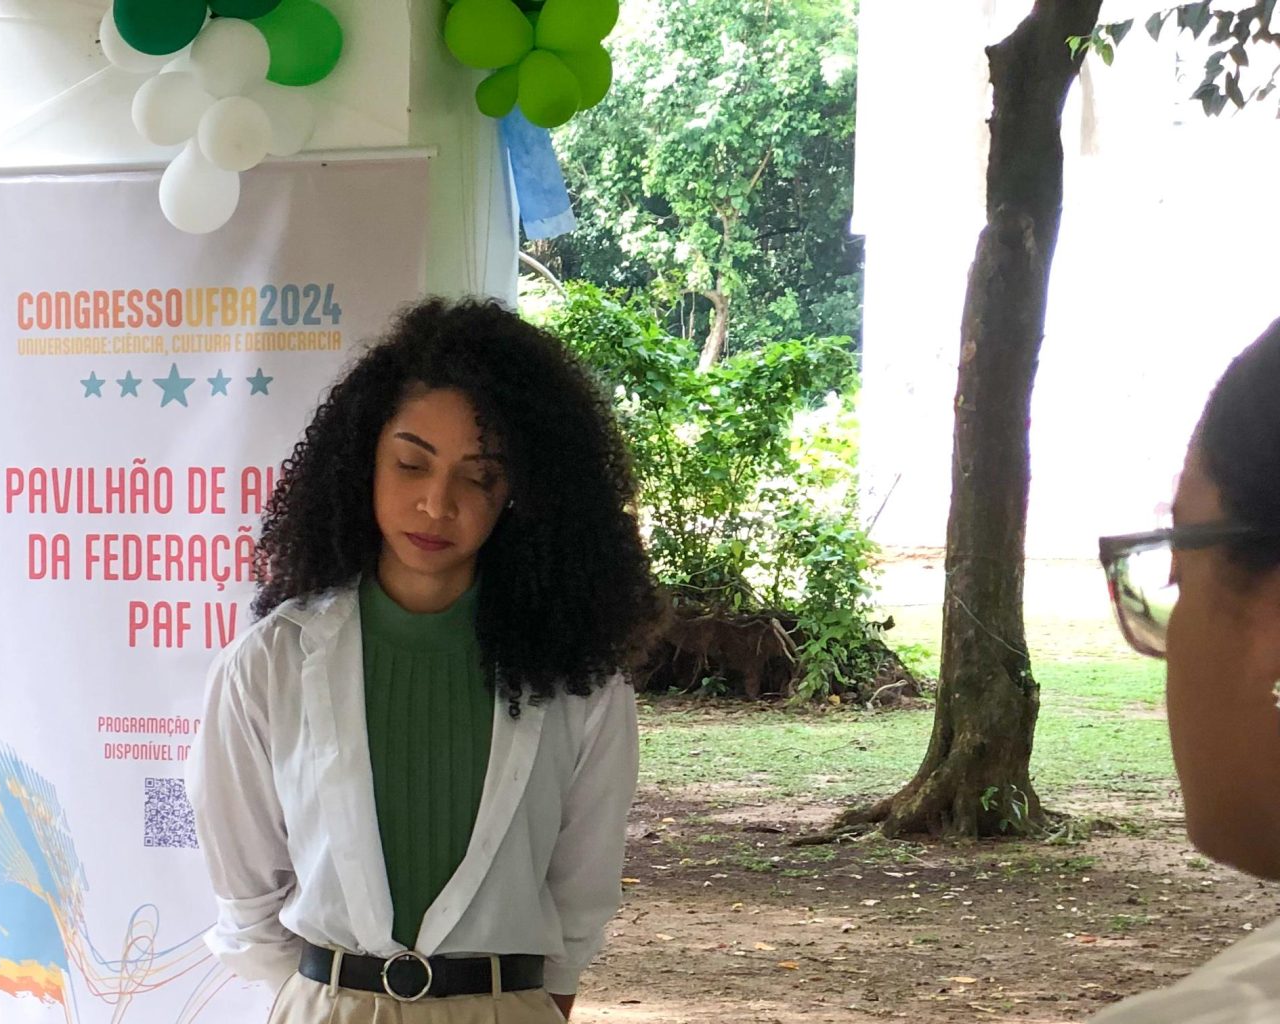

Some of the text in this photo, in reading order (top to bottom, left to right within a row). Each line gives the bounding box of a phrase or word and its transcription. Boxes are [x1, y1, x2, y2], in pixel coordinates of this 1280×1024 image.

[172, 333, 231, 353] CULTURA
[235, 333, 241, 352] E
[246, 330, 341, 352] DEMOCRACIA
[6, 458, 173, 514] PAVILHÃO
[188, 467, 226, 514] DE
[28, 526, 265, 591] DA FEDERAÇÃ
[129, 601, 237, 648] PAF IV
[98, 716, 190, 737] PROGRAMAÇÃO
[104, 741, 173, 760] DISPONÍVEL
